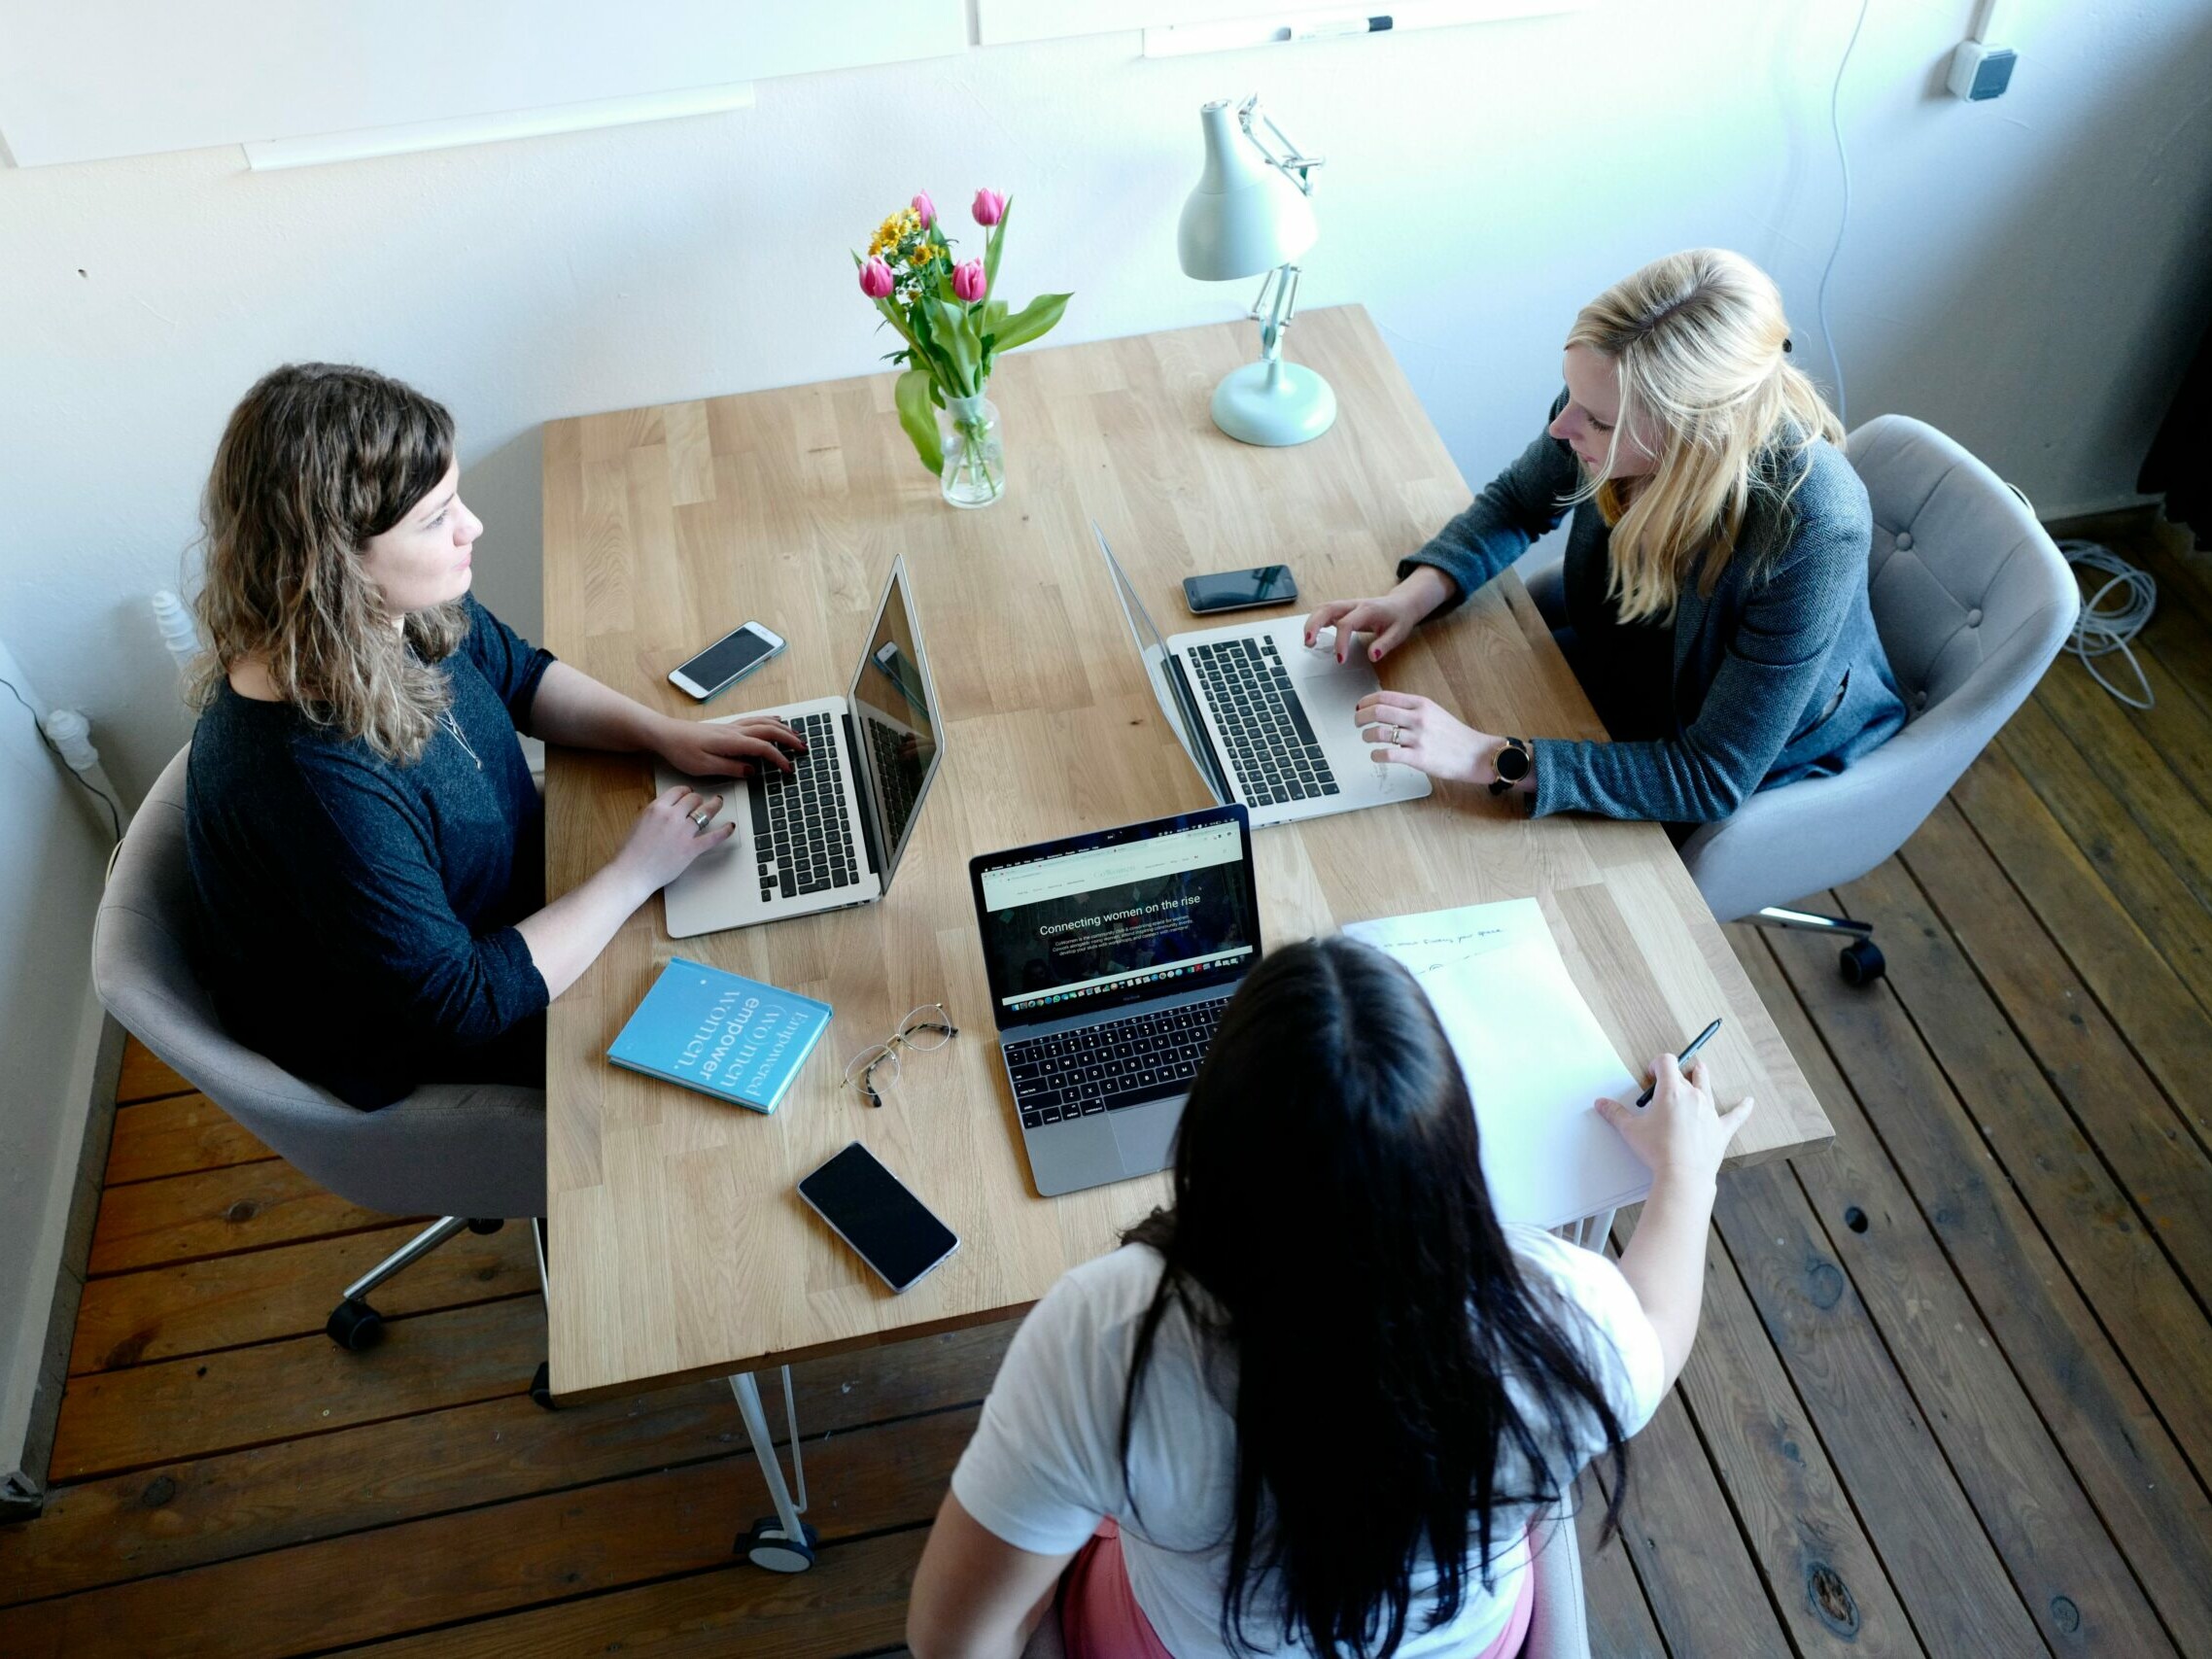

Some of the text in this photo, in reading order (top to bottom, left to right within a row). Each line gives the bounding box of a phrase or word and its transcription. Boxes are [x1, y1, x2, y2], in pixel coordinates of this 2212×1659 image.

[1040, 895, 1200, 937] Connecting women on the rise
[674, 991, 741, 1070] women.
[700, 997, 759, 1081] empower
[720, 1004, 787, 1088] (wo)men
[745, 1012, 809, 1096] Empowered
